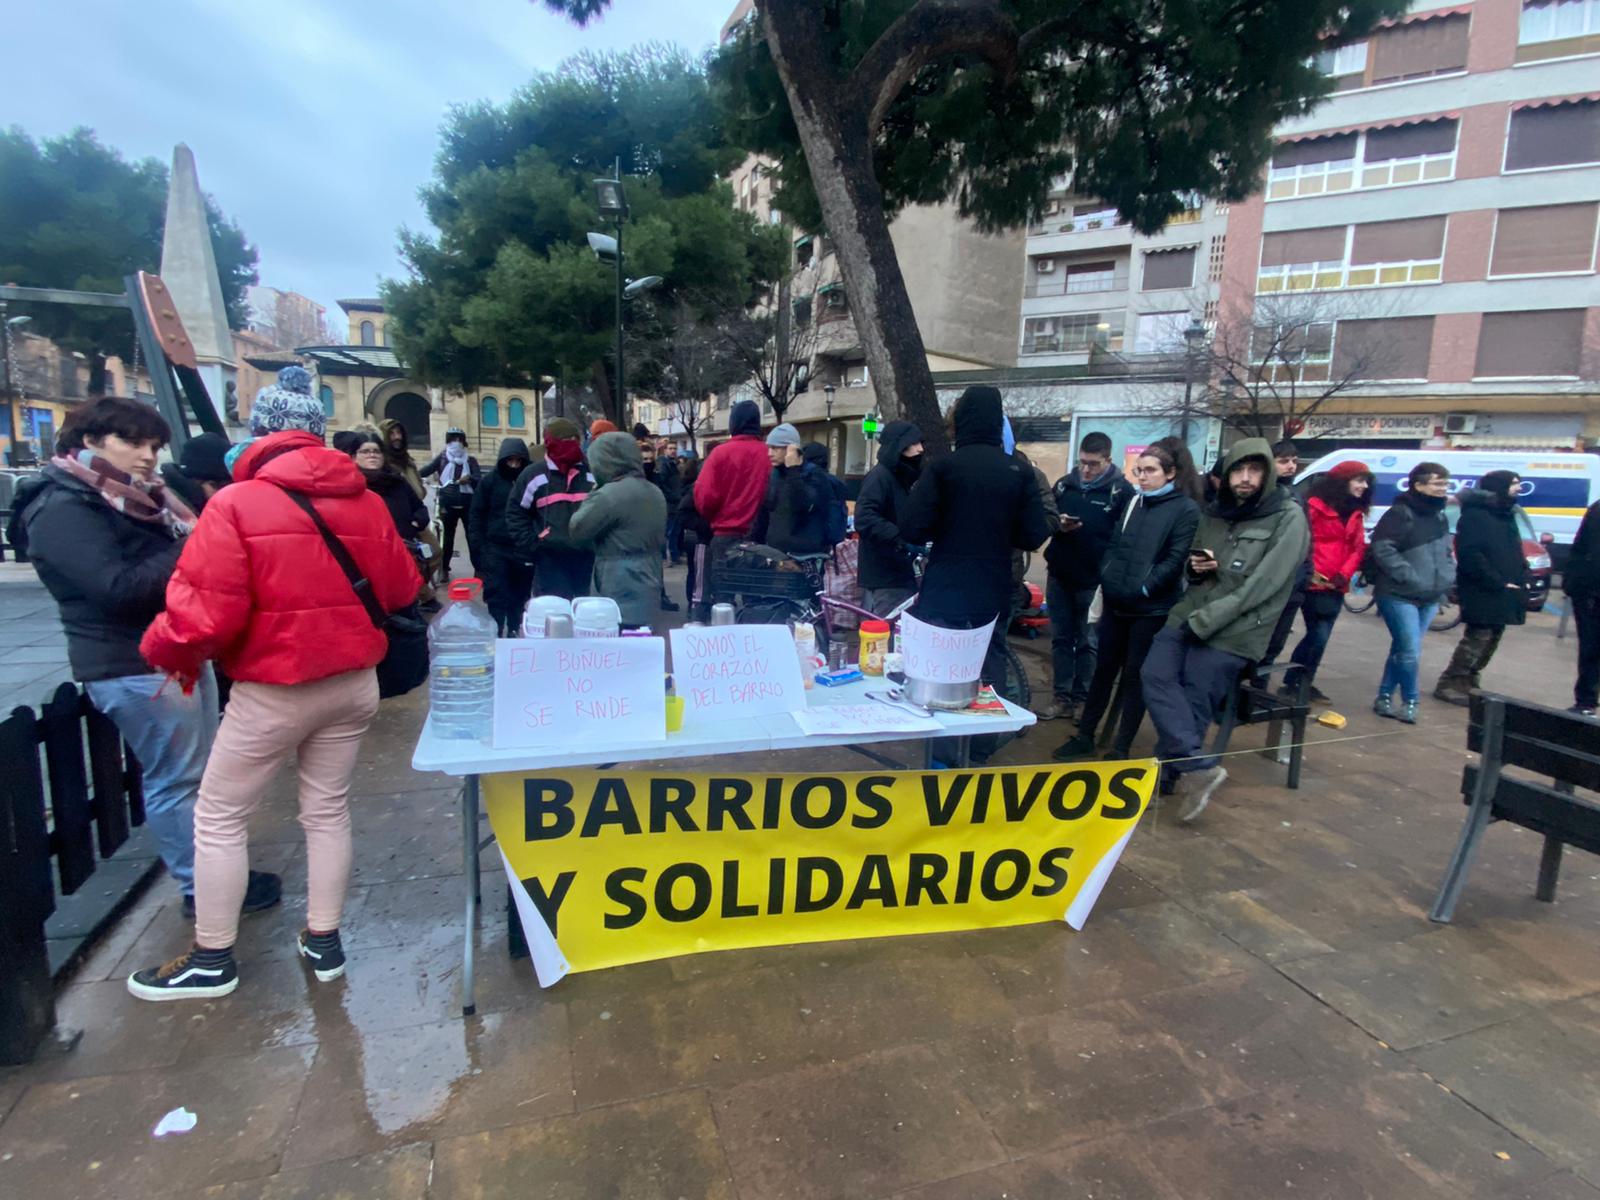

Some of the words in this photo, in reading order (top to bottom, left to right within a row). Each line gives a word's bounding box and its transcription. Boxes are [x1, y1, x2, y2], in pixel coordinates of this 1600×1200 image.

[1380, 417, 1429, 428] DOMINGO
[905, 619, 919, 640] EL
[686, 632, 736, 659] SOMOS
[744, 633, 764, 654] EL
[510, 647, 544, 676] EL
[556, 649, 631, 673] BUÑUEL
[923, 659, 942, 678] SE
[567, 676, 593, 695] NO
[691, 687, 722, 710] DEL
[728, 681, 784, 704] BARRIO
[523, 702, 552, 728] SE
[575, 696, 632, 720] RINDE
[523, 776, 896, 841] BARRIOS
[921, 768, 1147, 826] VIVOS
[521, 871, 578, 940] Y
[604, 847, 1074, 929] SOLIDARIOS
